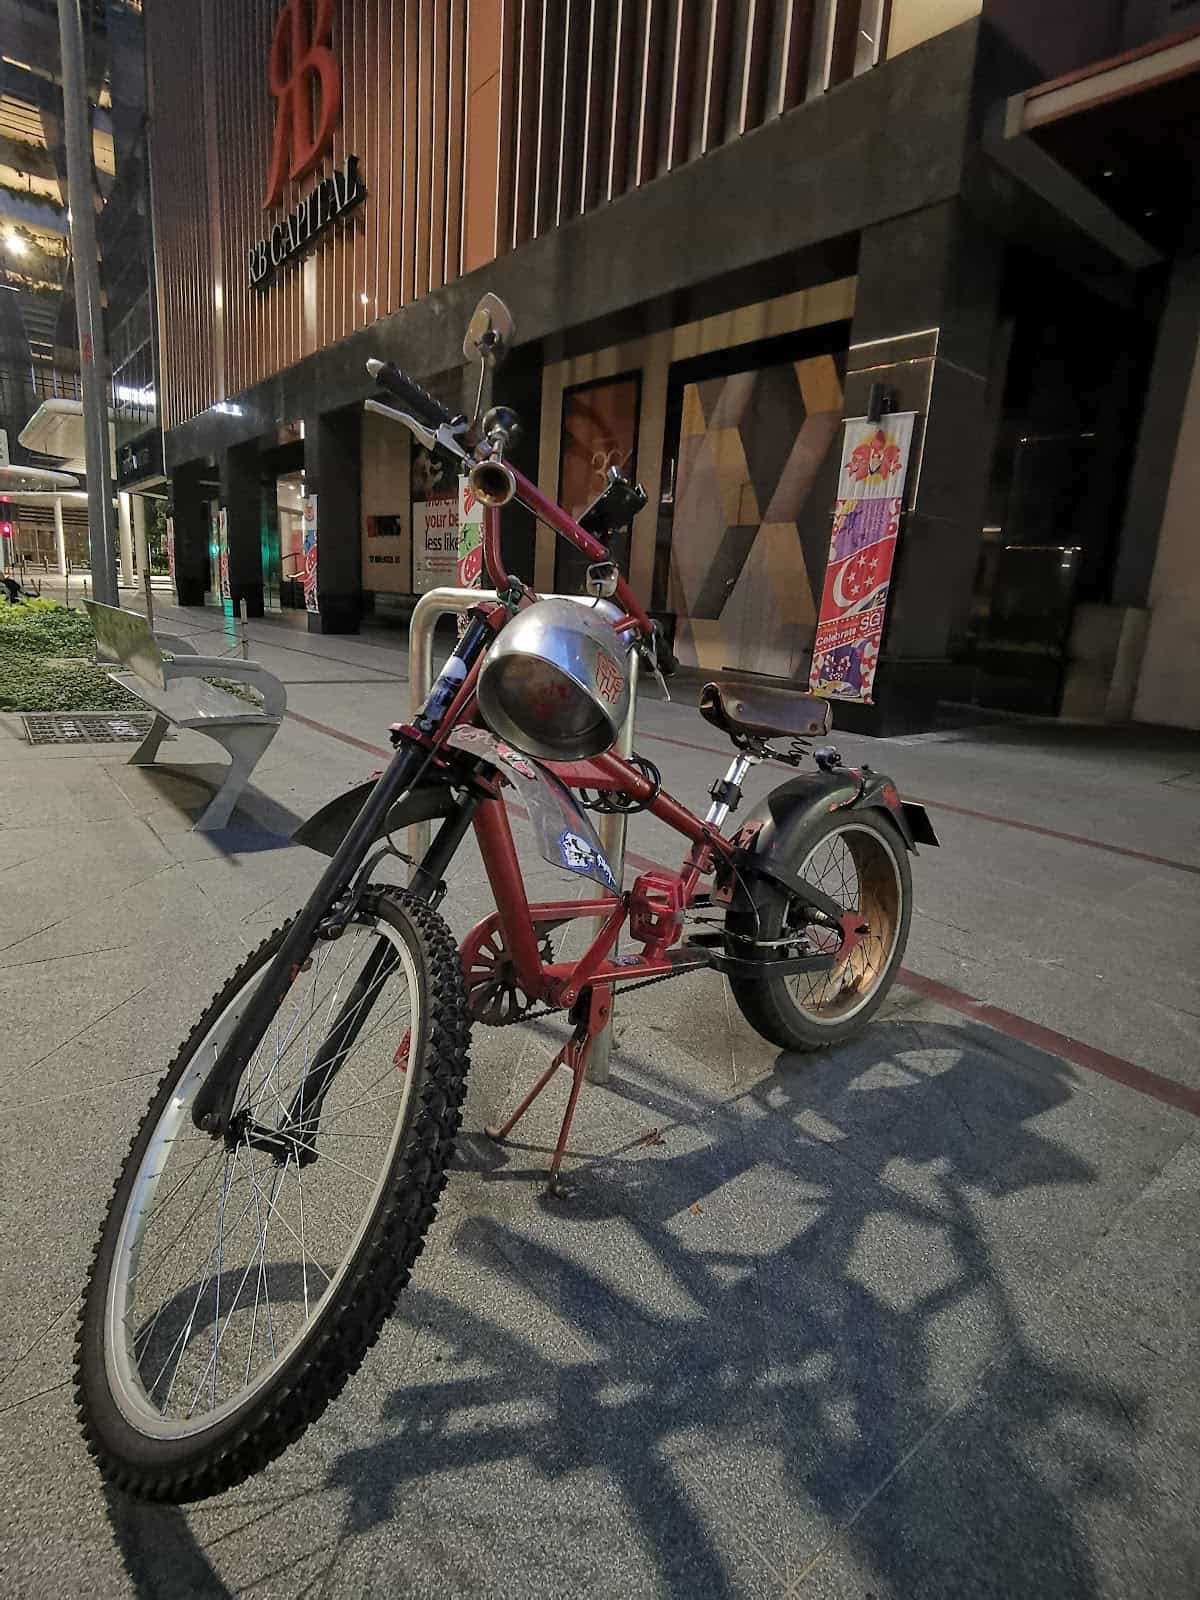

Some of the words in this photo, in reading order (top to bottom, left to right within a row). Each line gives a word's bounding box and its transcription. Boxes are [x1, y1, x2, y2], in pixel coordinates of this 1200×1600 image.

[248, 239, 268, 289] RB
[270, 155, 361, 267] CAPITAL
[425, 512, 448, 532] your
[425, 532, 443, 551] less
[815, 627, 856, 646] Celebrate
[859, 612, 880, 630] SG
